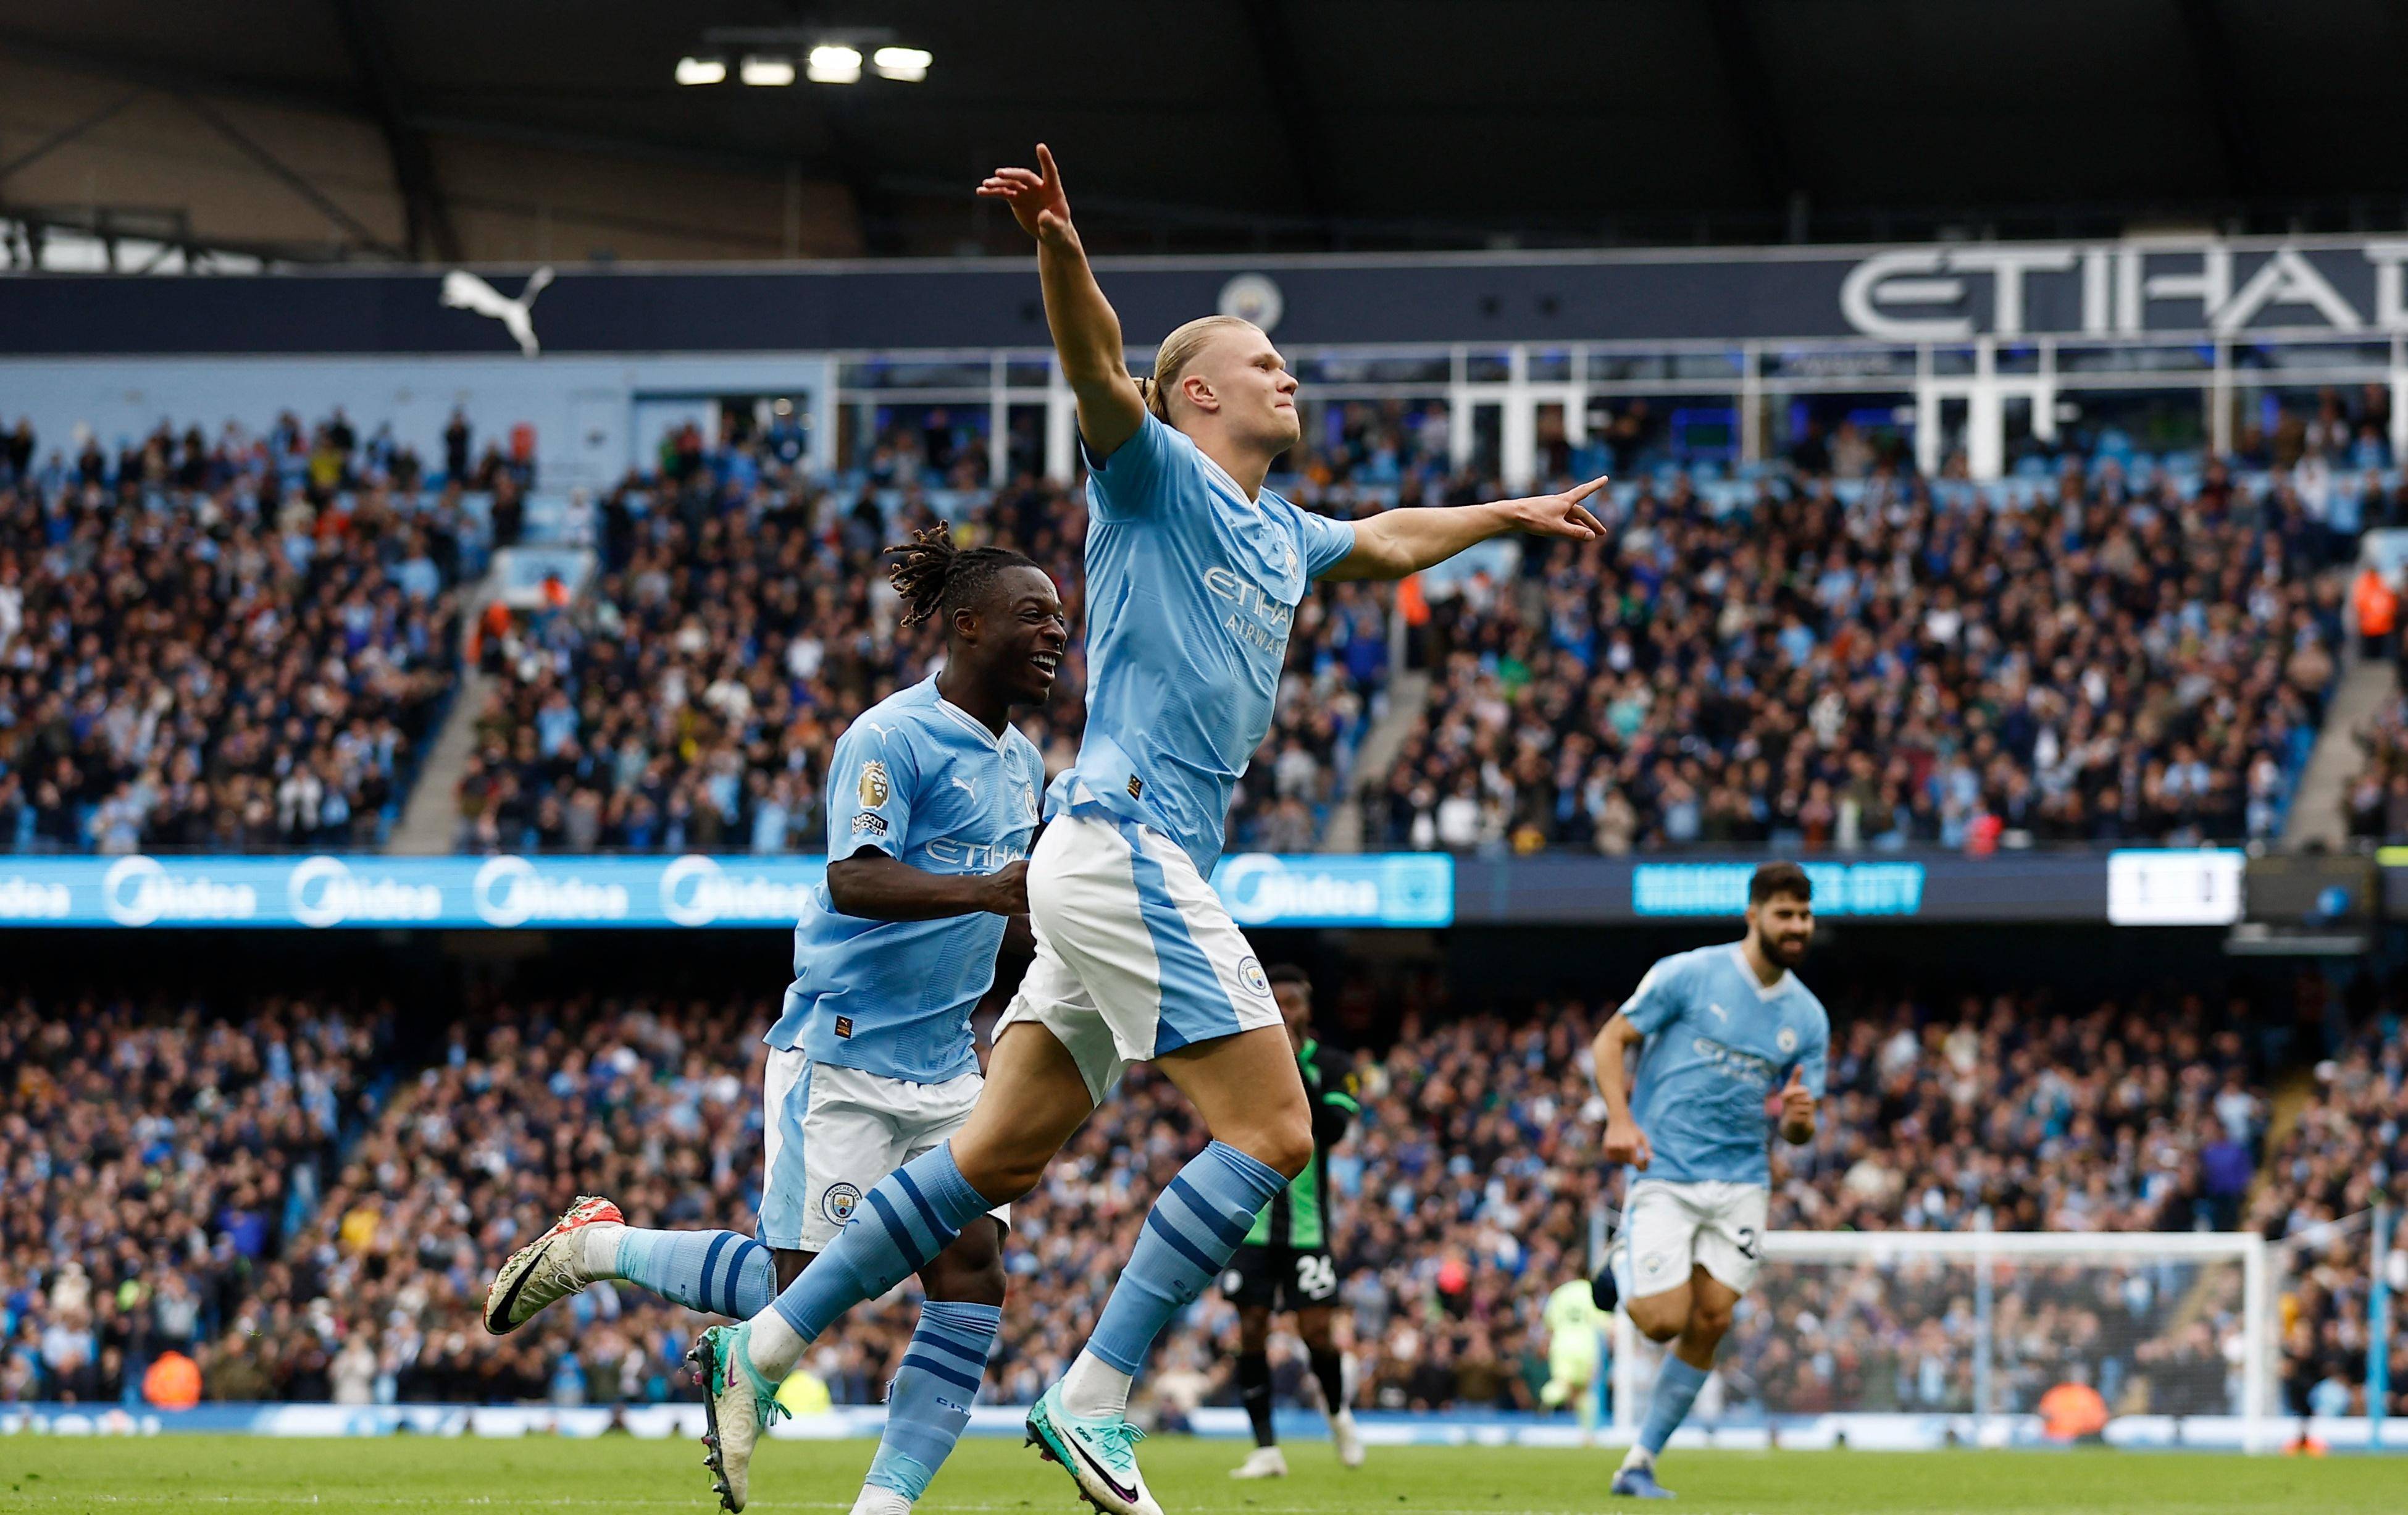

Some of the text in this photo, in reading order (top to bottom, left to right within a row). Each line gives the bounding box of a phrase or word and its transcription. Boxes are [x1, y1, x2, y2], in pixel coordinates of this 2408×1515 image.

[1204, 566, 1291, 632] ETIHA
[1225, 614, 1284, 660] AIRWAY
[926, 837, 1027, 867] ETIHA
[827, 1186, 859, 1201] MANCHESTER
[1296, 1254, 1337, 1300] 26
[936, 1397, 968, 1414] CIT
